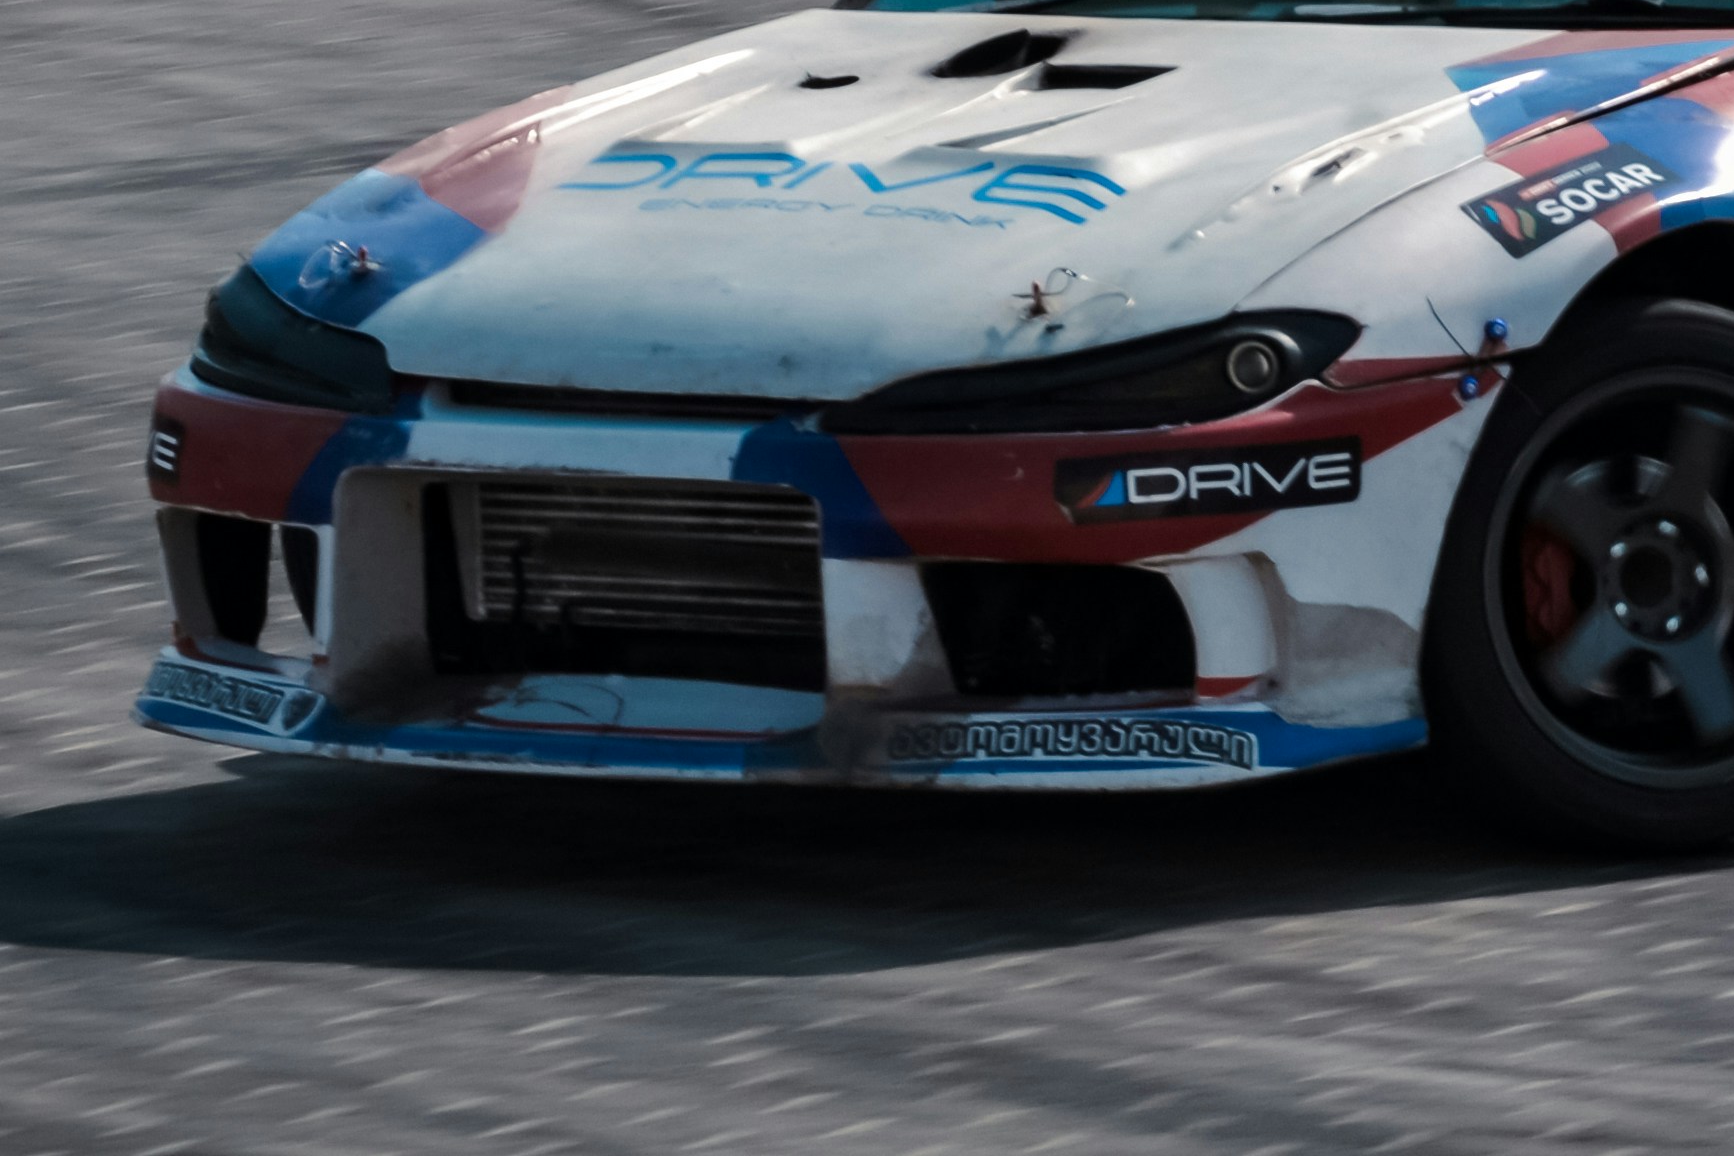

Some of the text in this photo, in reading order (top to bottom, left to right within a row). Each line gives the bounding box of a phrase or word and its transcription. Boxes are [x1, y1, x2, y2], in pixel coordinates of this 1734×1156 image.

[557, 151, 1127, 225] DRIVE
[1535, 162, 1665, 225] SOCAR
[1125, 452, 1352, 504] DRIVE
